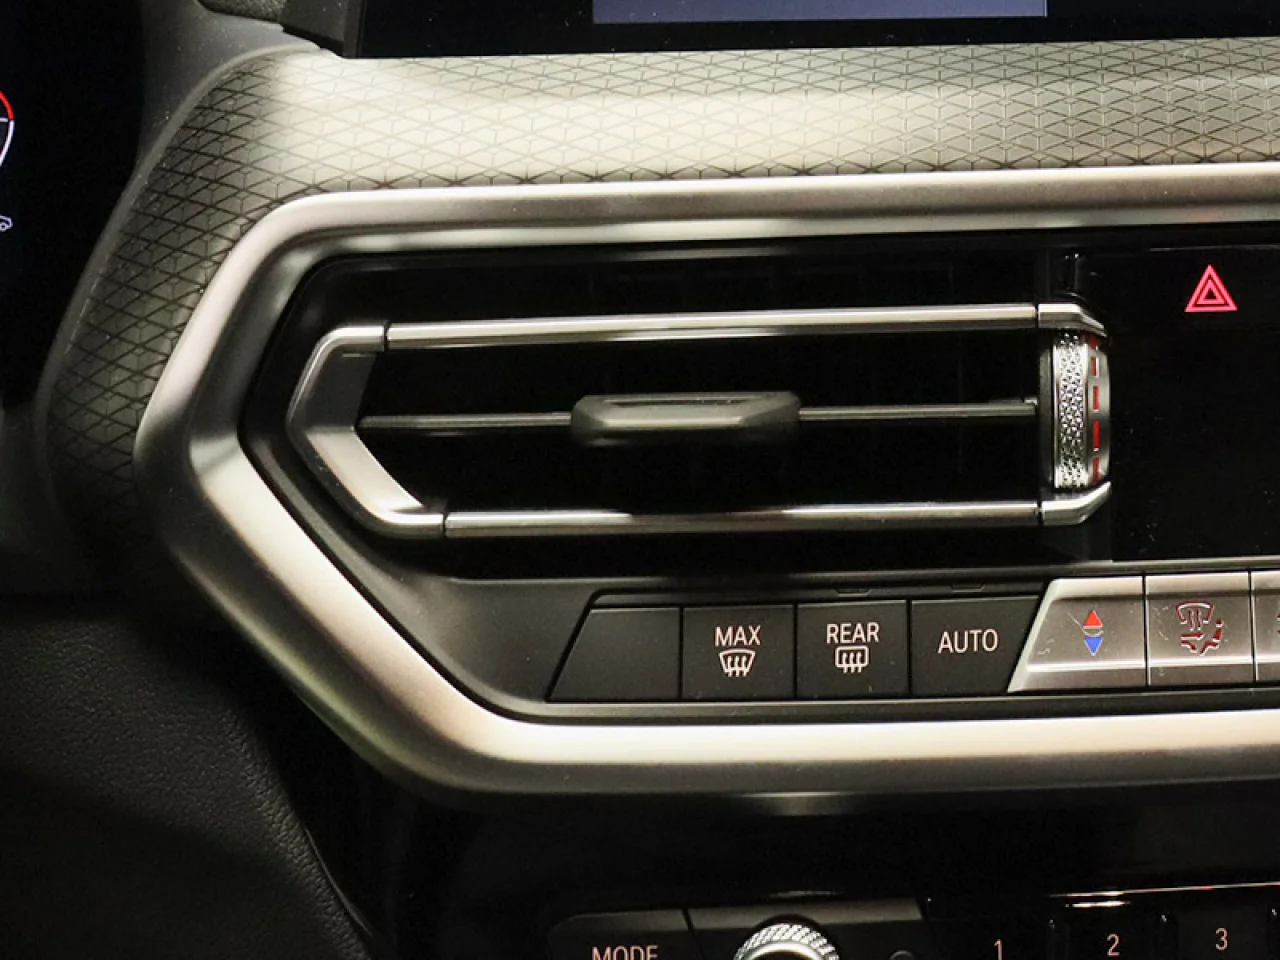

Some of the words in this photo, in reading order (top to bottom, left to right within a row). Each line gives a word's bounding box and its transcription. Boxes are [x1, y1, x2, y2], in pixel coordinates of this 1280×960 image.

[714, 625, 761, 647] MAX
[826, 621, 880, 644] REAR
[937, 628, 999, 654] AUTO
[994, 939, 1003, 960] 1
[1107, 933, 1120, 956] 2
[1215, 927, 1228, 951] 3
